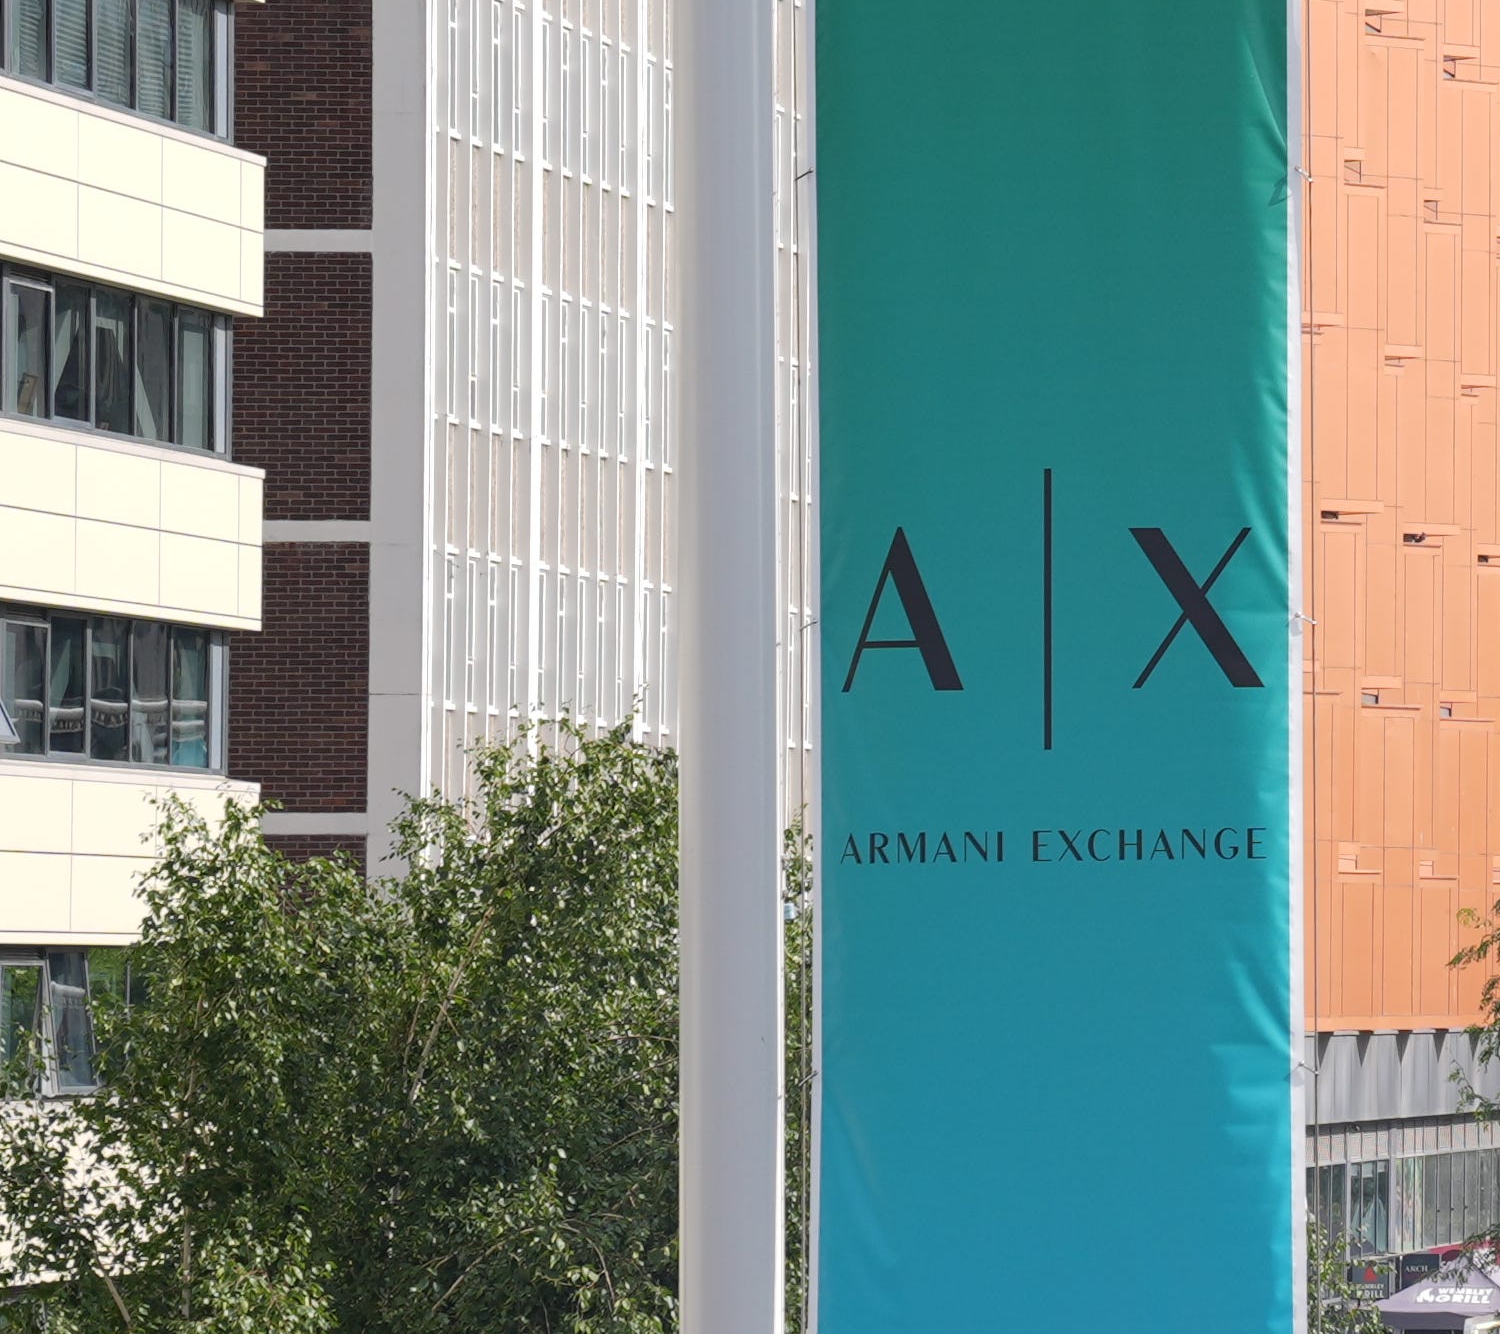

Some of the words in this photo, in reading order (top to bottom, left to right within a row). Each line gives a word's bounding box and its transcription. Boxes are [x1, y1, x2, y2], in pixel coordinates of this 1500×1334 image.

[840, 830, 1004, 865] ARMANI
[1031, 827, 1267, 863] EXCHANGE
[1405, 1264, 1429, 1273] ARCH
[1438, 1287, 1494, 1296] WEMBLEY
[1435, 1294, 1491, 1305] GRILL
